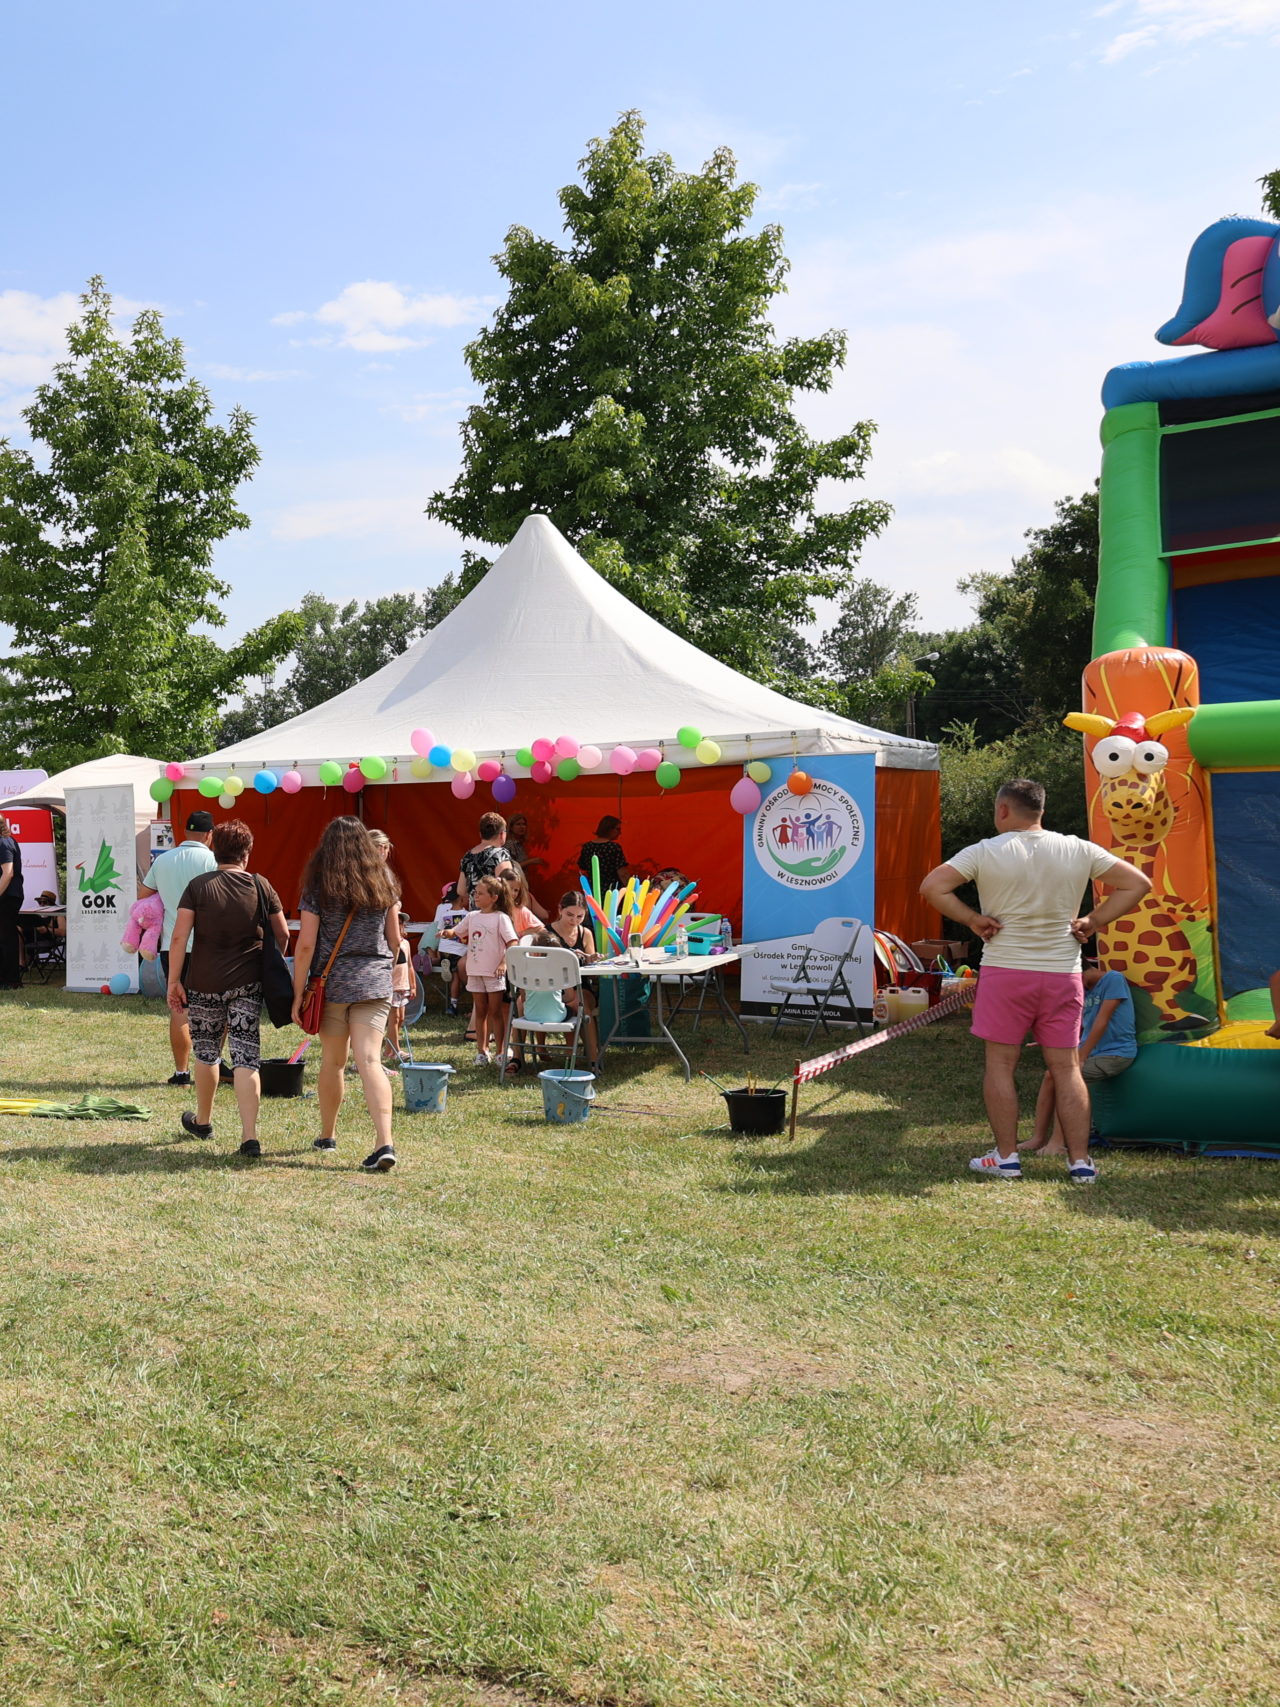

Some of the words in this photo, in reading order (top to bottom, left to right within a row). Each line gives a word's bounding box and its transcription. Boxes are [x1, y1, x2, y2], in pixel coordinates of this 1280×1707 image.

[757, 813, 768, 848] GMINNY
[765, 788, 789, 811] OŚROD
[813, 782, 839, 797] MOCY
[838, 796, 860, 847] SPOŁECZNEJ
[777, 870, 786, 879] W
[786, 871, 838, 886] LESZNOWOLI
[82, 895, 116, 908] GOK
[787, 953, 818, 962] Pomcy
[790, 963, 833, 971] Lesnowoli
